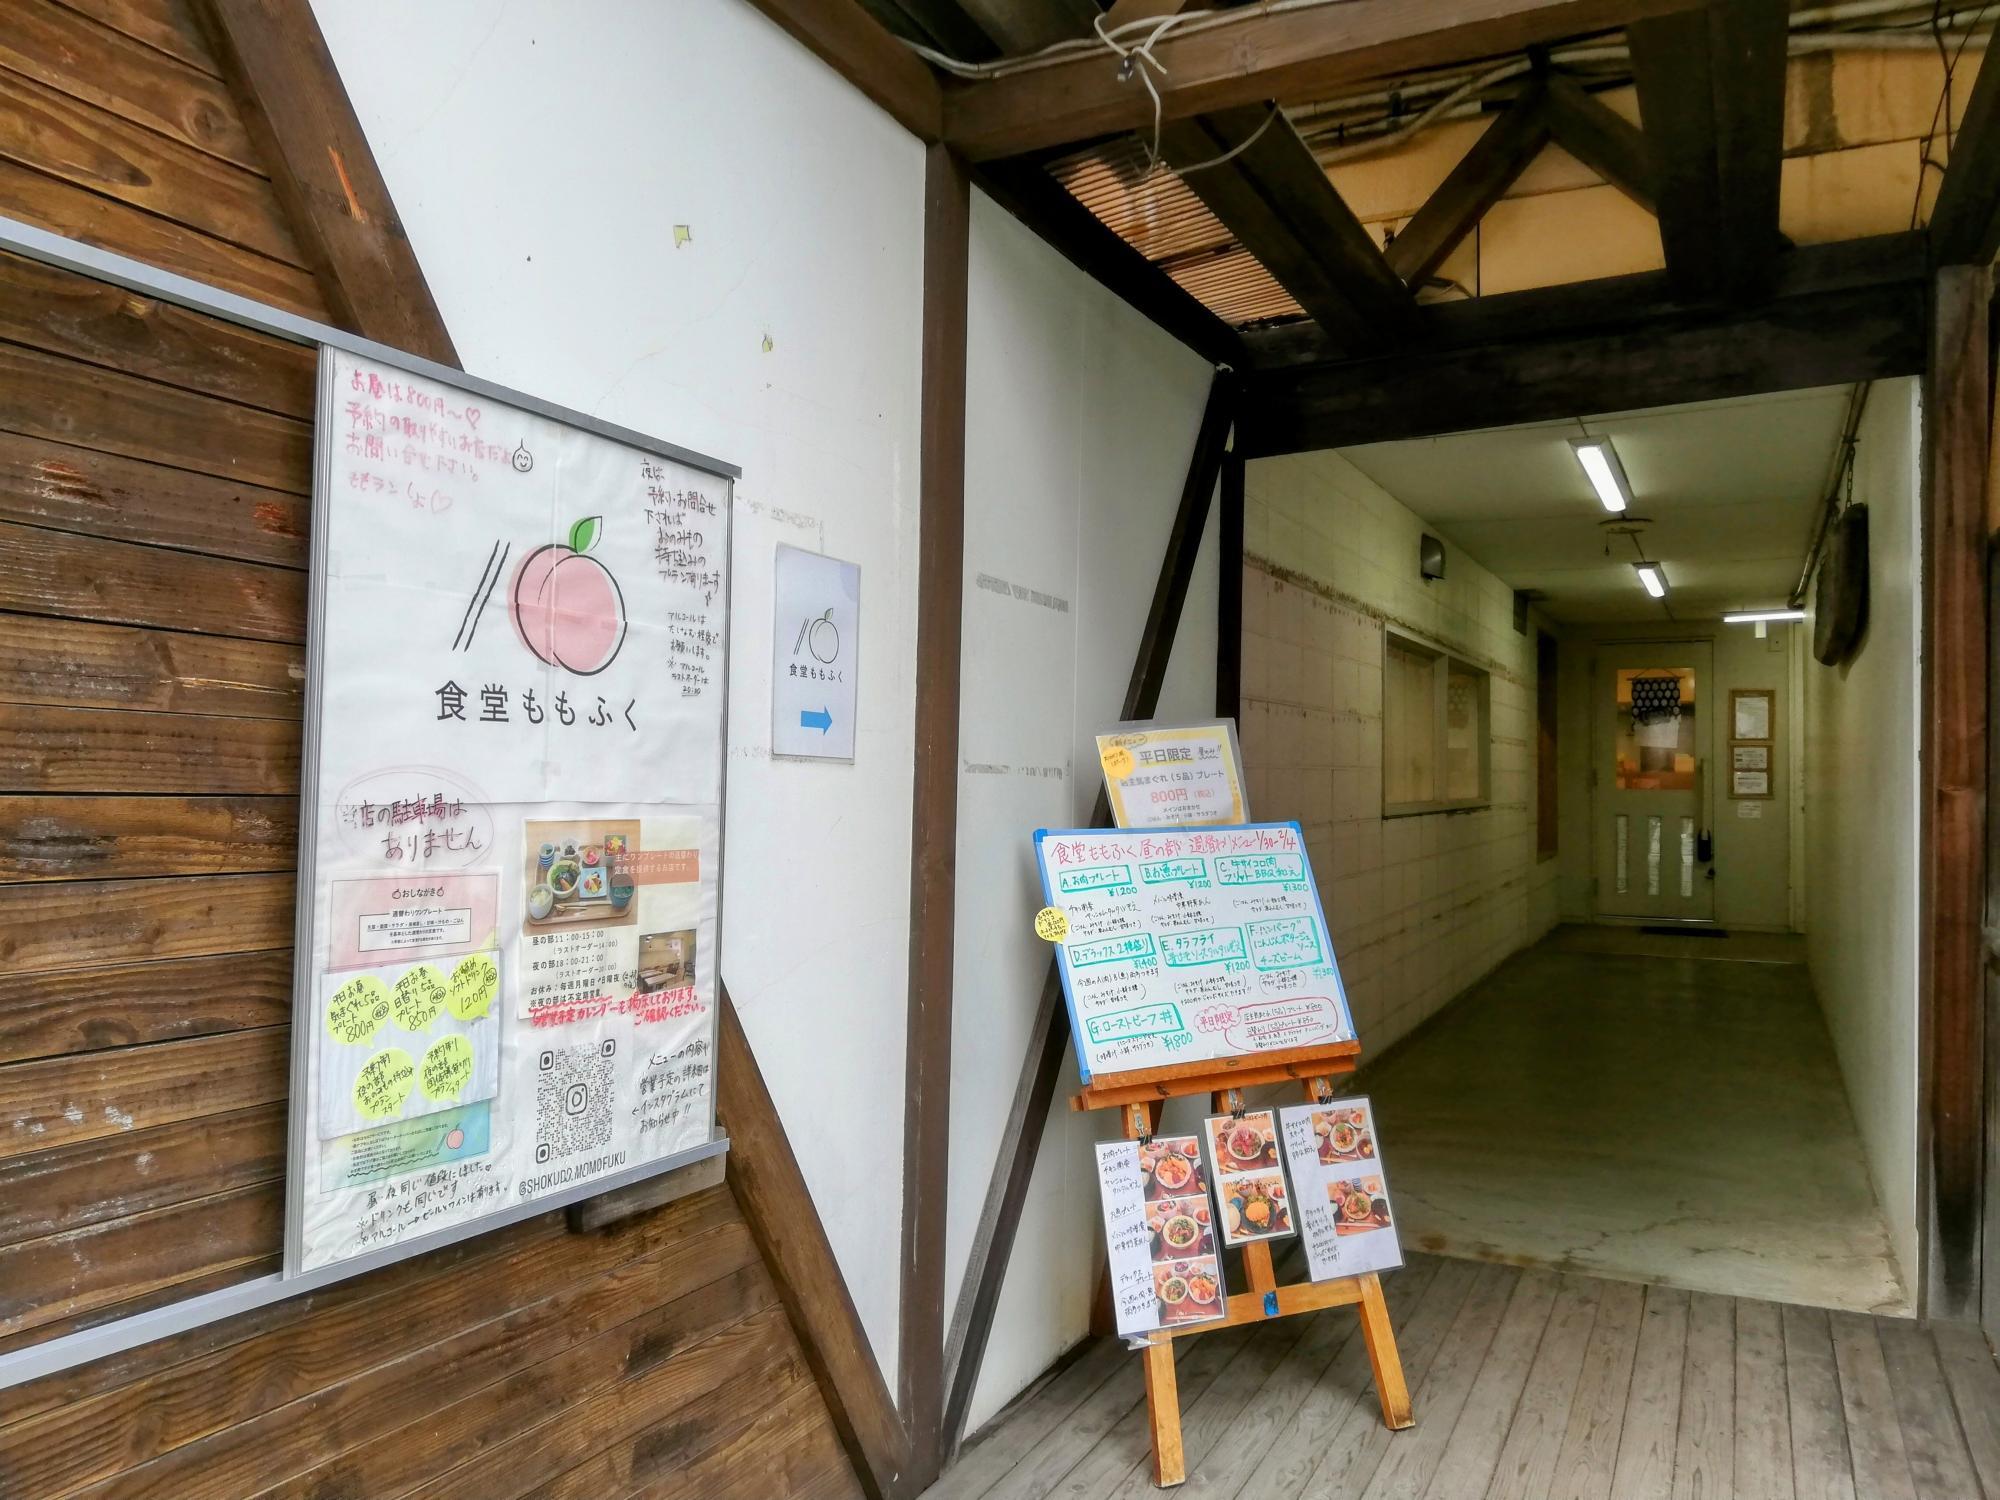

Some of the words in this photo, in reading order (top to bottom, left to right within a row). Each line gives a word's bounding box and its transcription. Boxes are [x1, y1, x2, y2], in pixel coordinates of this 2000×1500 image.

[789, 663, 843, 682] 食堂ももふく
[435, 680, 637, 732] 食堂ももふく
[1140, 747, 1194, 764] 平日限定
[1151, 788, 1188, 803] 800円
[381, 826, 482, 862] ありません
[1050, 842, 1138, 865] 食堂ももふく
[402, 887, 437, 898] おしながき
[460, 984, 488, 1014] 120円
[1200, 1010, 1236, 1028] 平日限定
[345, 1020, 375, 1043] 800円
[518, 1151, 627, 1196] @SHOKUDO.MOMOFUKU
